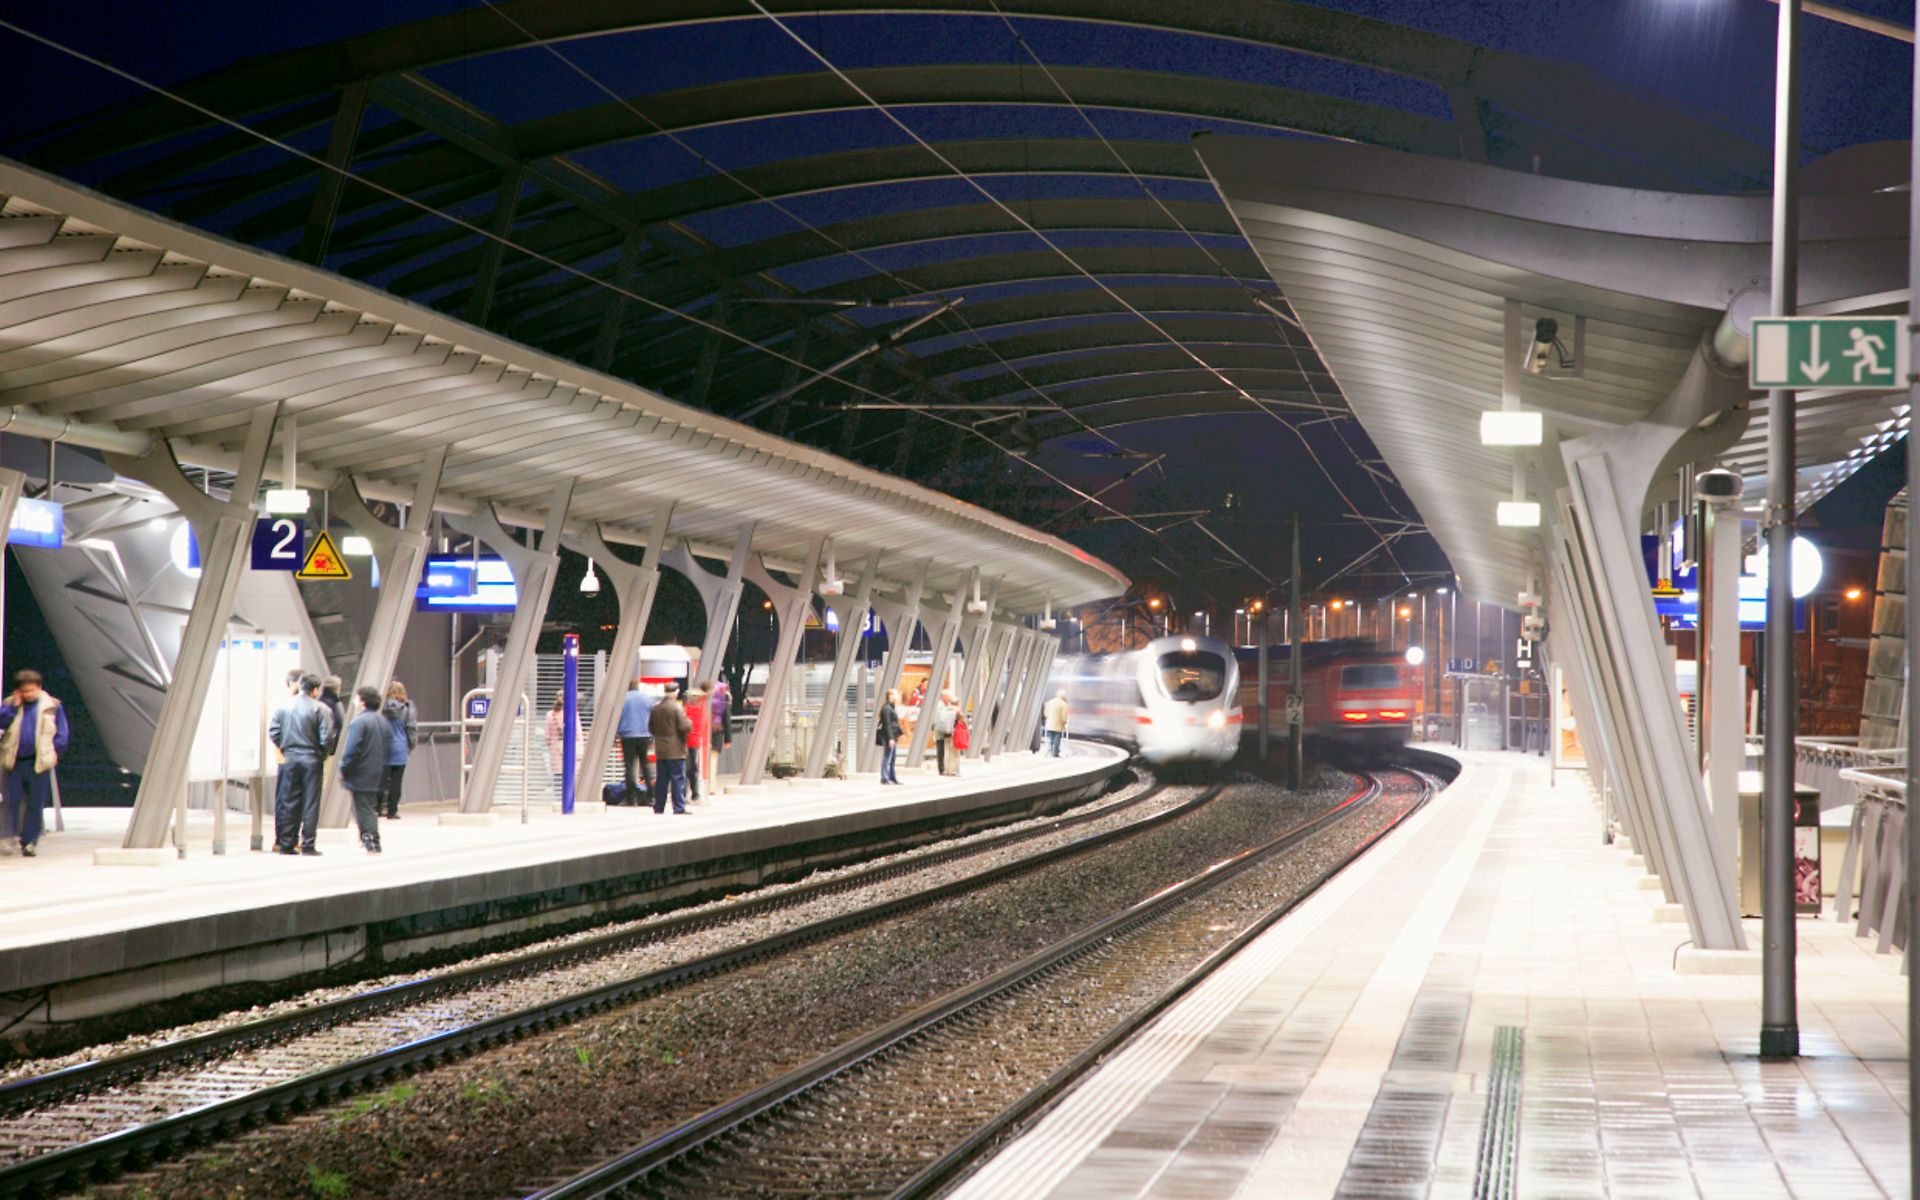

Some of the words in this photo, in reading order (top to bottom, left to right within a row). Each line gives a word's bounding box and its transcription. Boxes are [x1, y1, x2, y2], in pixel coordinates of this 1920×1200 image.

[270, 519, 297, 559] 2
[1516, 638, 1532, 658] H
[1464, 658, 1473, 670] D
[1287, 695, 1303, 708] 27
[1291, 710, 1300, 721] 2
